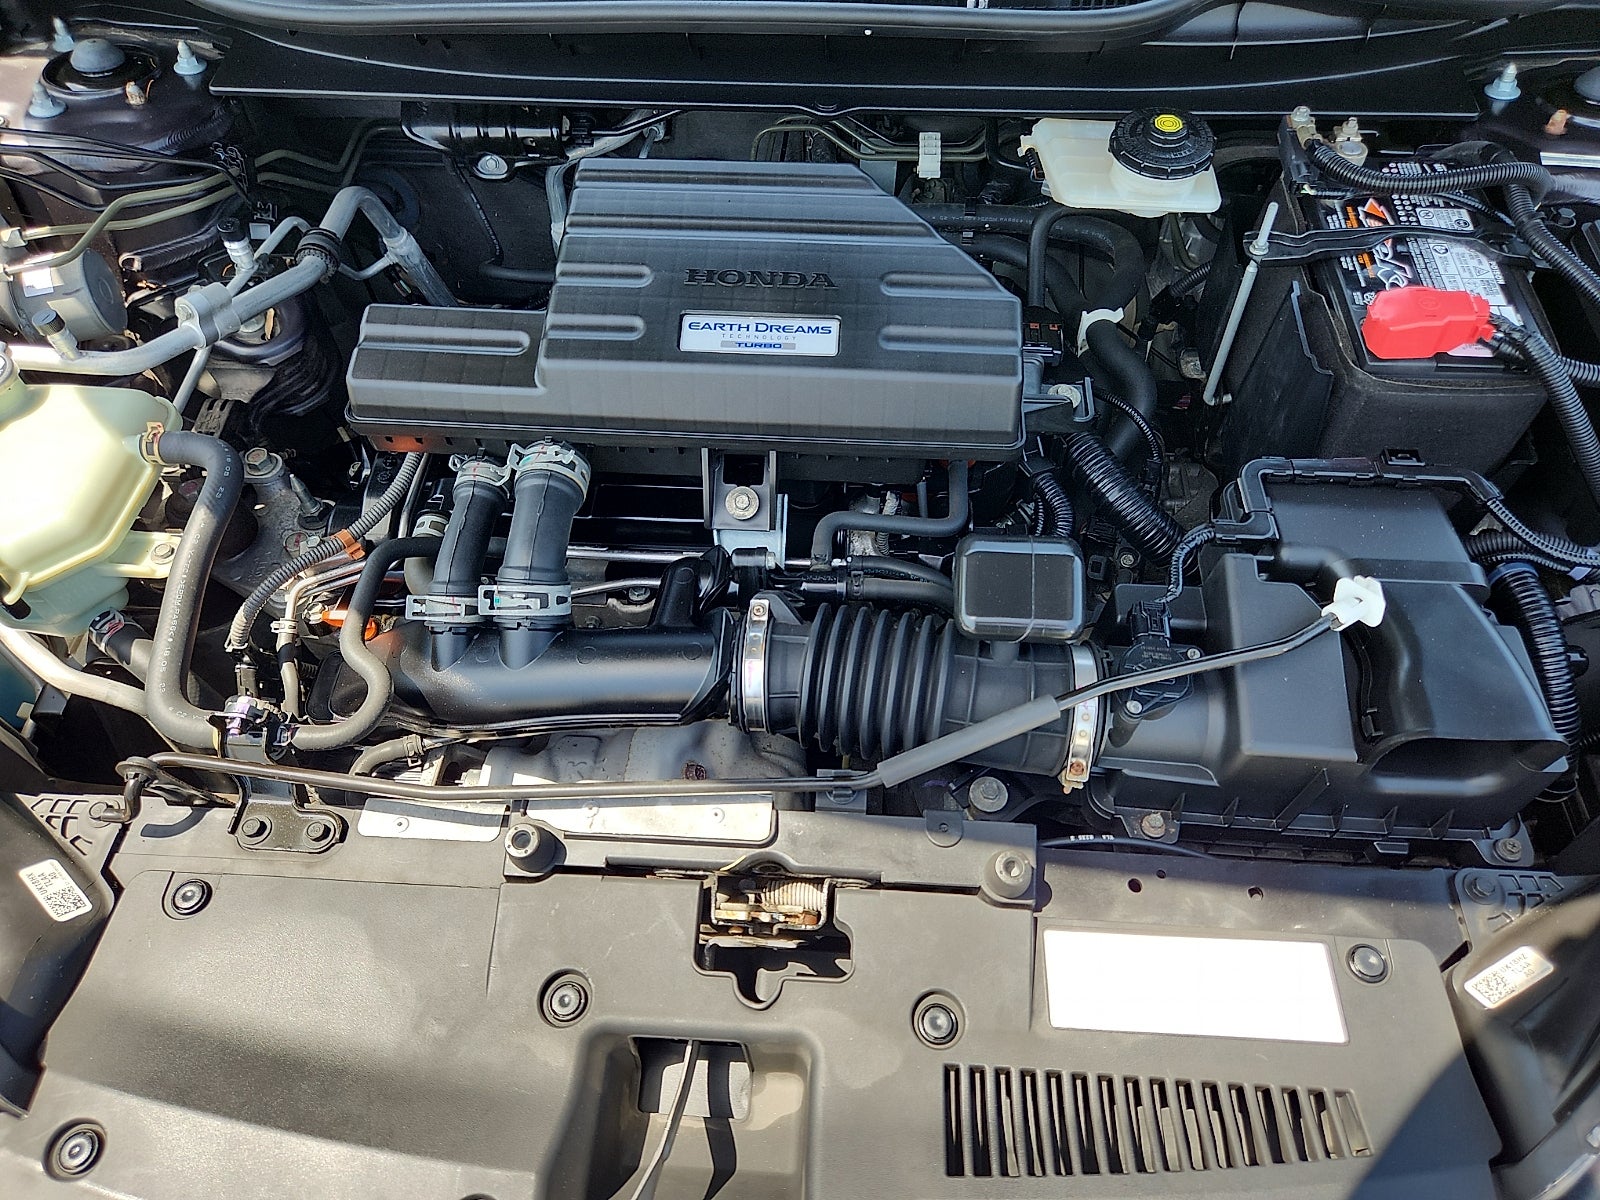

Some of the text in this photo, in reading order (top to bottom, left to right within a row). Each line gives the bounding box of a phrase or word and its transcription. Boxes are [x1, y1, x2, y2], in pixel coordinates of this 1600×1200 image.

[684, 268, 839, 289] HONDA
[688, 321, 833, 335] EARTH DREAMS
[722, 333, 797, 341] TECHNOLOGY
